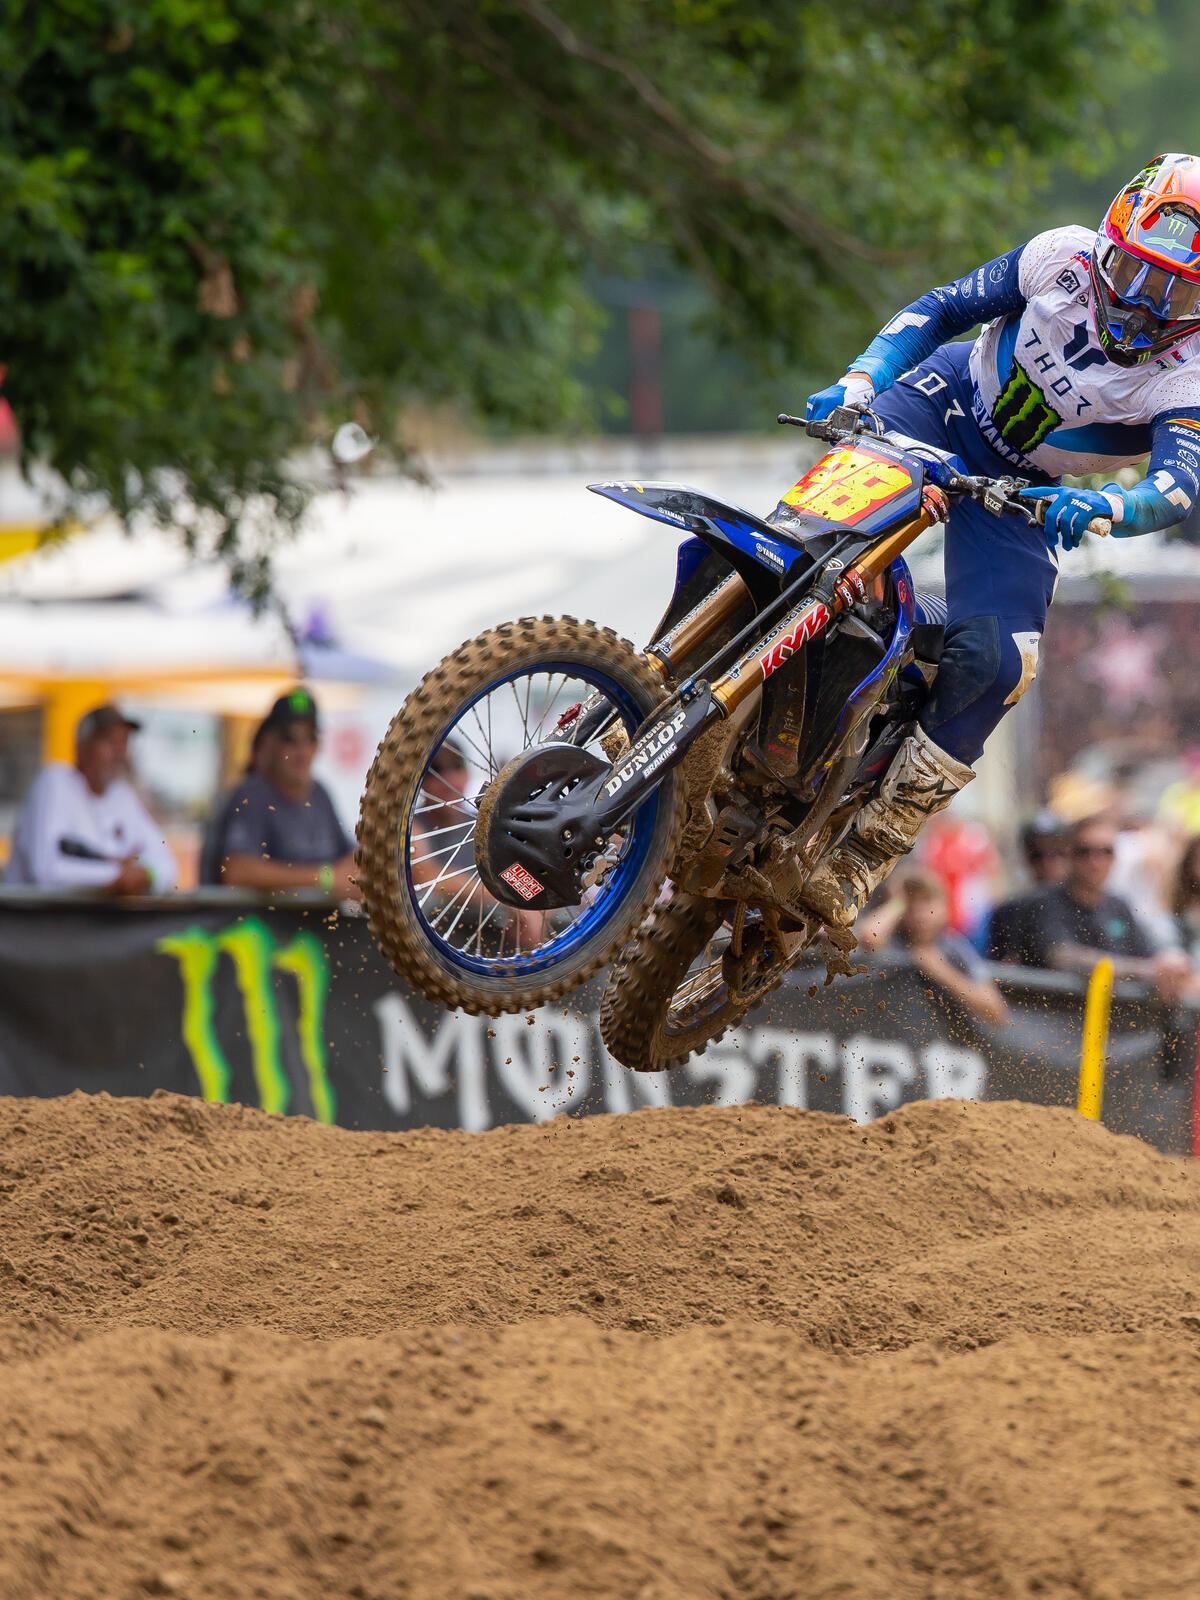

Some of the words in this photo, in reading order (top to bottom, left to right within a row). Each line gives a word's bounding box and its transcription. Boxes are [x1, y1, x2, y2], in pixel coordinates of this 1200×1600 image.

[1025, 328, 1093, 416] THOR
[971, 406, 1042, 472] YAMAH
[780, 449, 913, 523] 38
[1070, 498, 1093, 512] THOR
[762, 544, 785, 568] YAMAHA
[759, 604, 831, 680] KYB
[604, 711, 687, 798] DUNLOP
[643, 742, 678, 778] BRAKING
[503, 872, 534, 899] SPEED
[511, 865, 542, 893] LIGHT
